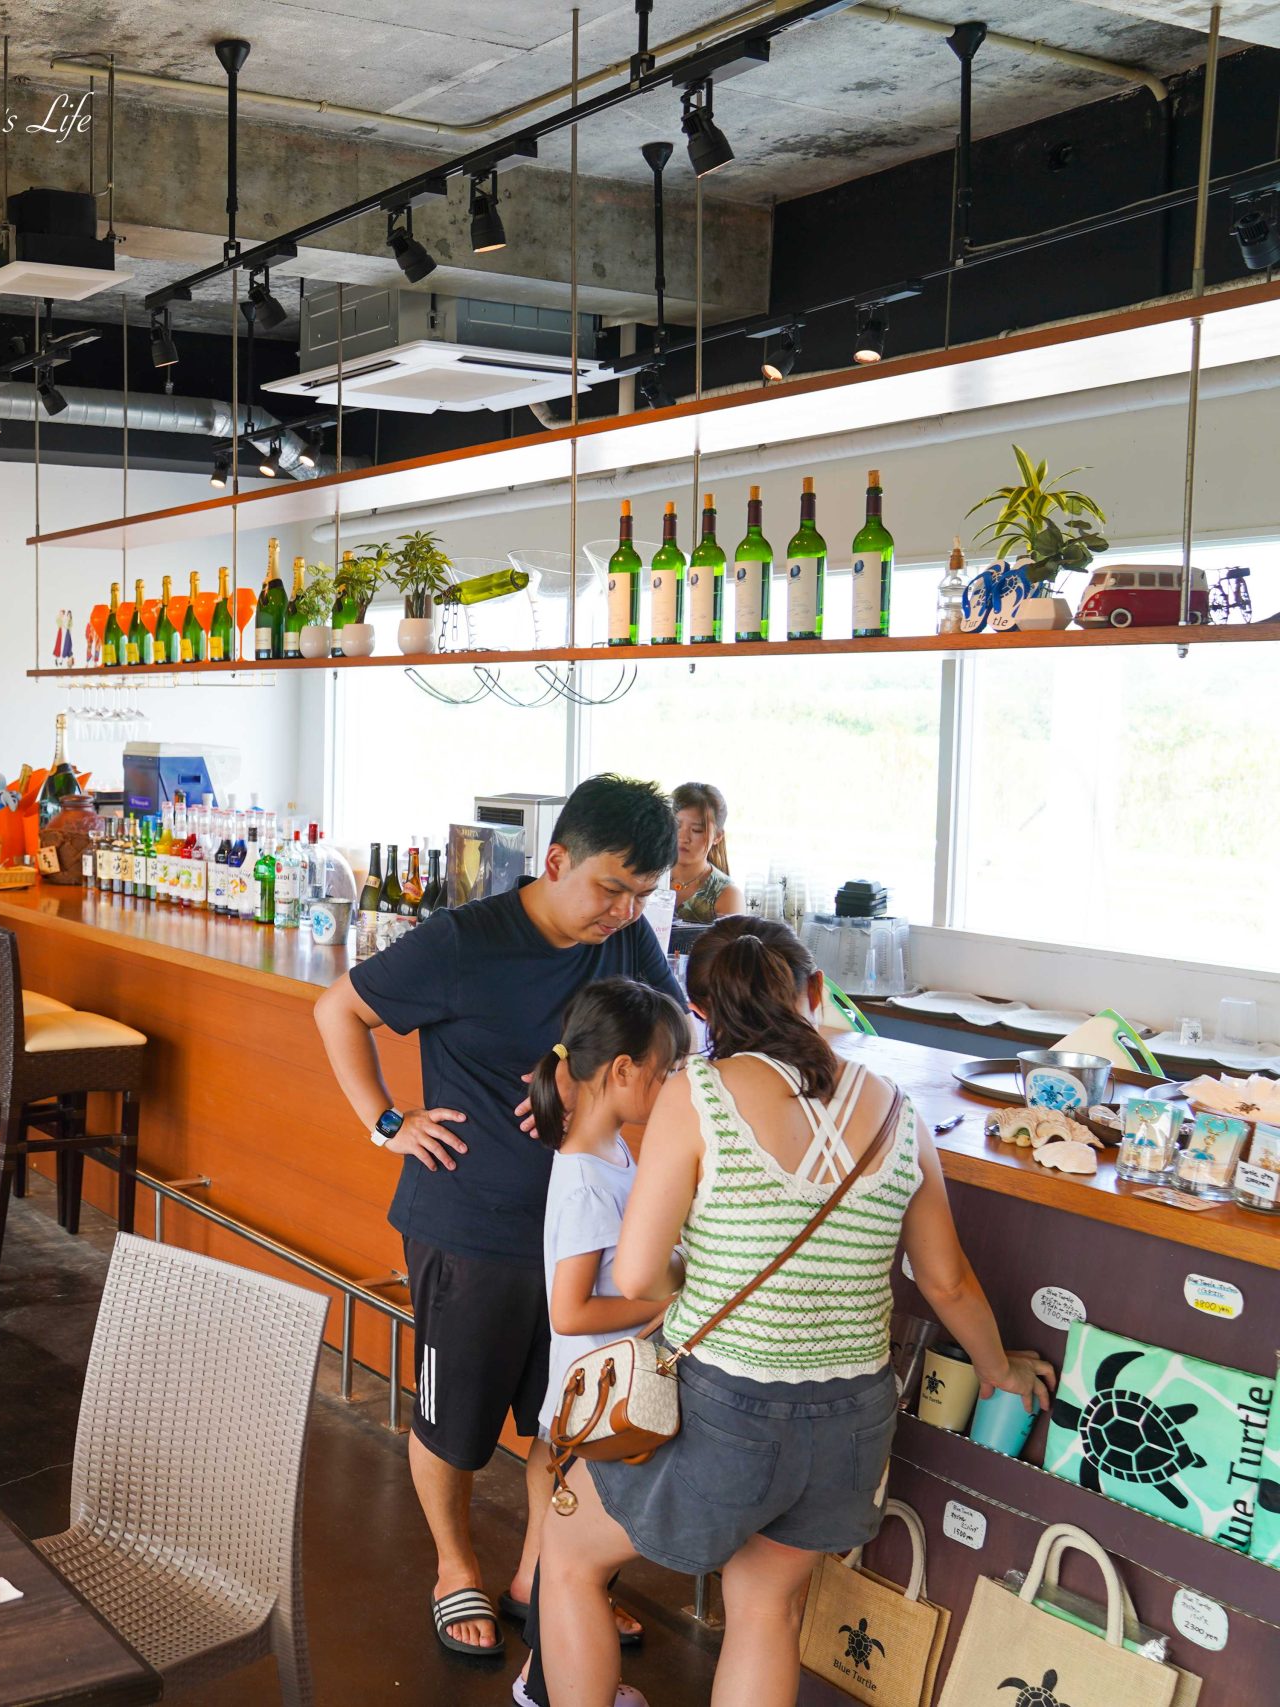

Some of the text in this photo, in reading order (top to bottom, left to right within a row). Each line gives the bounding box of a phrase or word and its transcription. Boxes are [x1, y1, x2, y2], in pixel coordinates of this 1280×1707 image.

[1218, 1386, 1274, 1548] lue Turtle
[1183, 1620, 1205, 1635] 2300
[832, 1659, 877, 1692] Blue Turtle
